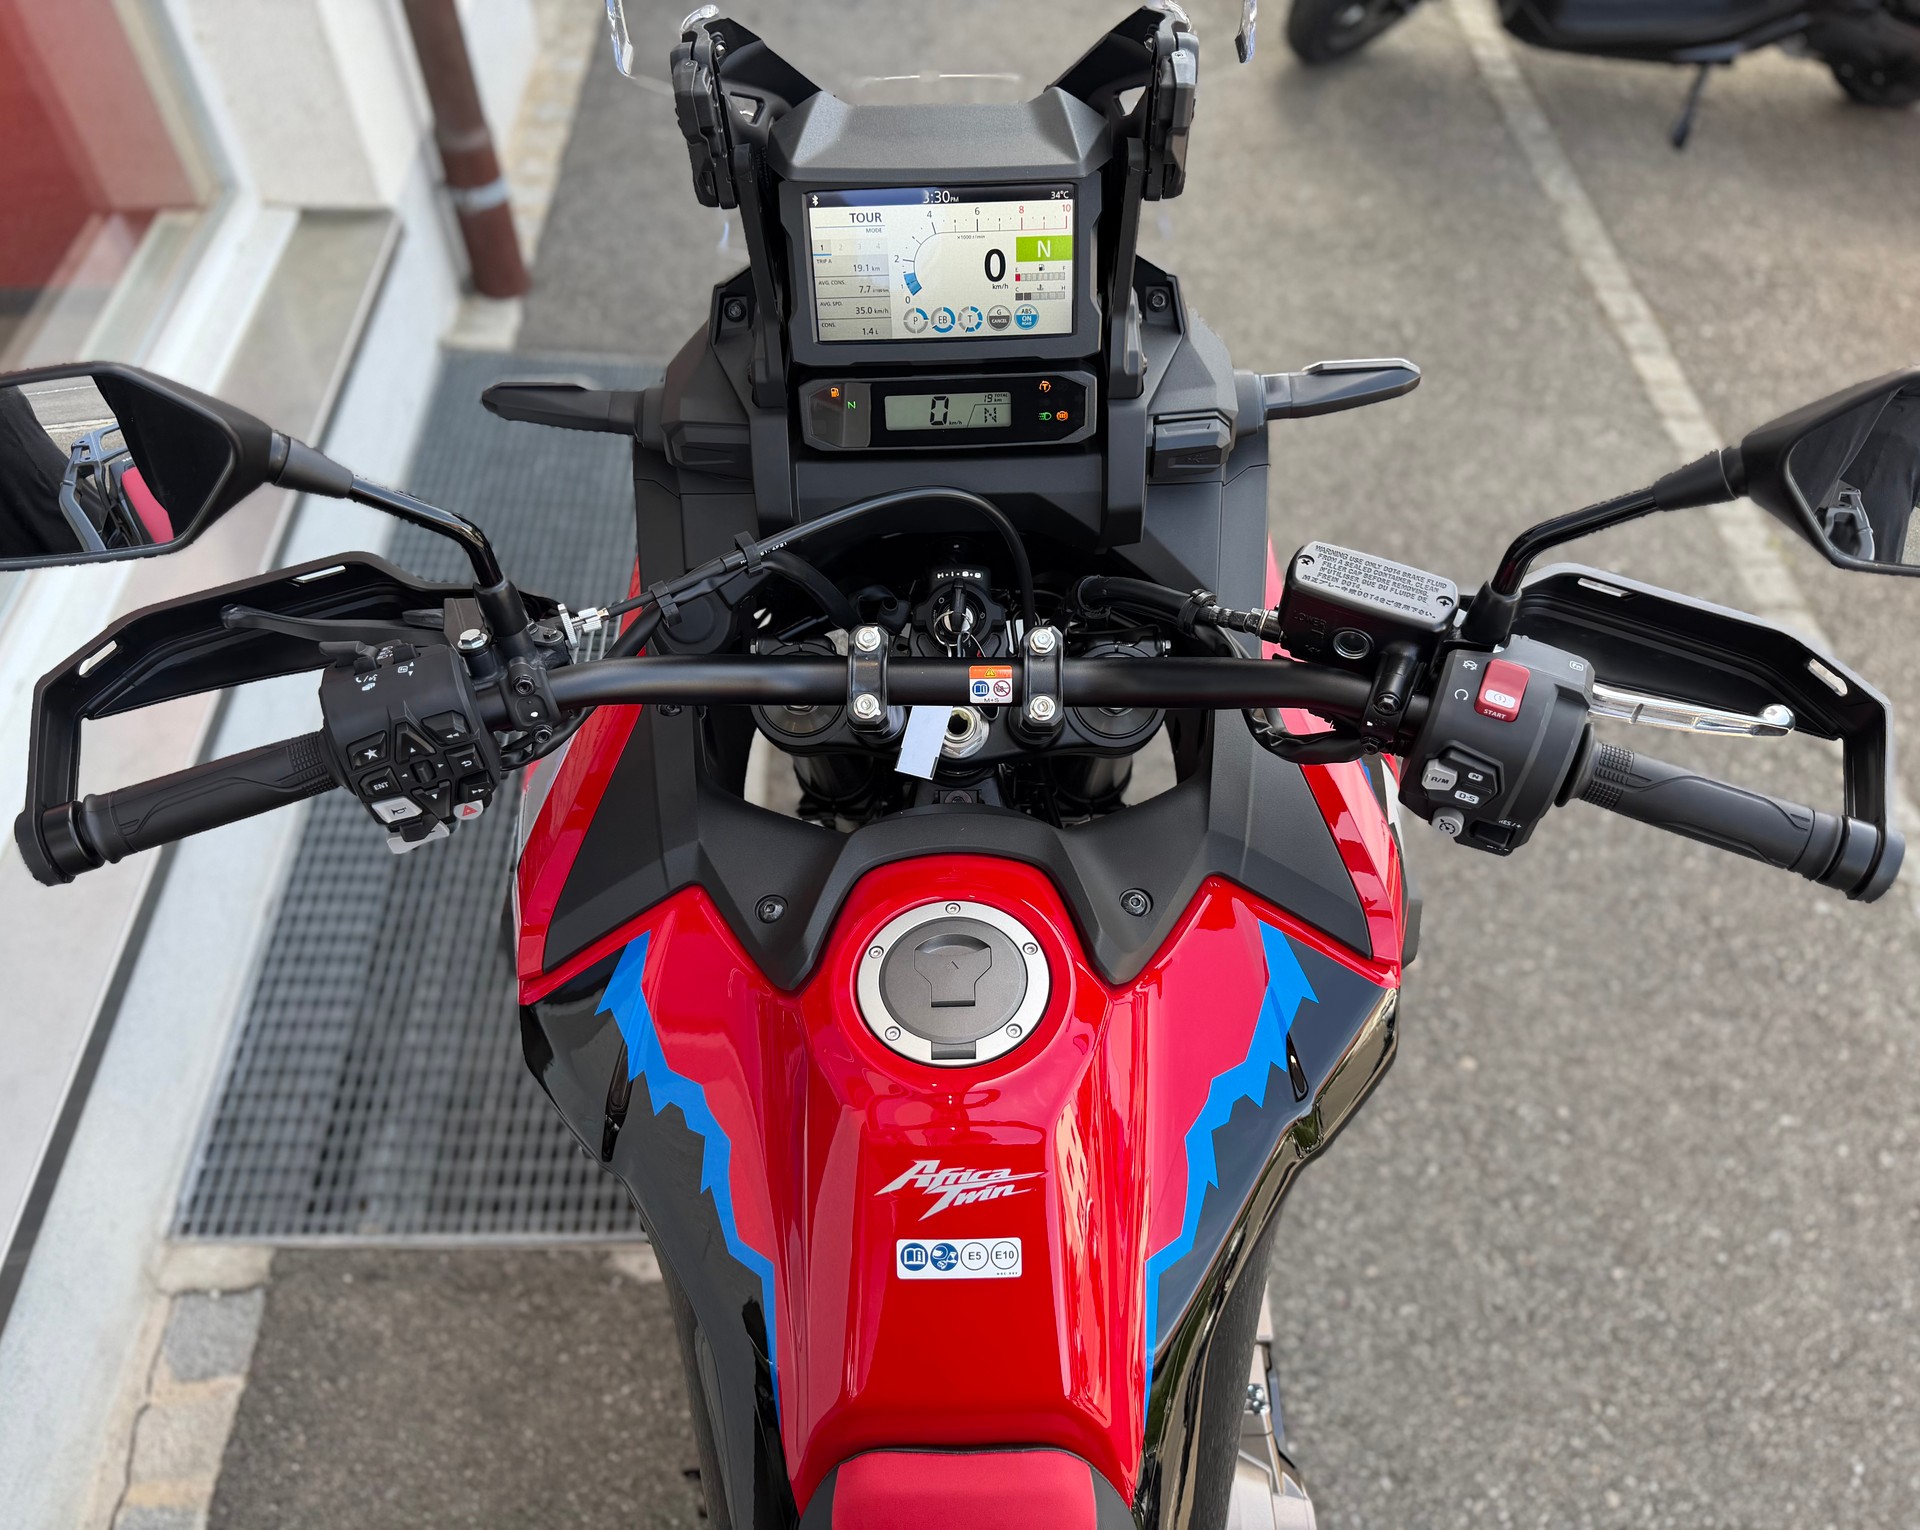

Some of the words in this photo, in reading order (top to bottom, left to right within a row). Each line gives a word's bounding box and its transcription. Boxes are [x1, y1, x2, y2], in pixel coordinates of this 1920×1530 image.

[923, 190, 950, 204] 3:30
[1050, 190, 1069, 200] 34°C
[974, 206, 980, 215] 6
[1018, 205, 1025, 214] 8
[1062, 203, 1072, 212] 10
[848, 212, 882, 223] TOUR
[926, 210, 932, 218] 4
[1037, 240, 1051, 258] N
[894, 254, 900, 263] 2
[853, 264, 870, 272] 19.1
[984, 248, 1006, 282] 0
[859, 285, 871, 293] 7.7
[905, 295, 911, 304] 0
[855, 306, 873, 315] 35.0
[913, 316, 919, 325] P
[938, 315, 948, 324] EB
[967, 315, 973, 323] T
[862, 327, 874, 335] 1.4
[984, 393, 993, 403] 19
[847, 401, 856, 409] N
[930, 395, 949, 426] 0
[984, 407, 997, 423] N
[1315, 544, 1349, 560] WARNING
[1349, 555, 1364, 565] USE
[1364, 560, 1383, 570] ONLY
[1383, 566, 1401, 575] DOT4
[1401, 571, 1425, 583] BRAKE
[1426, 578, 1447, 589] FLUID
[1317, 553, 1338, 563] FROM
[1344, 560, 1373, 574] SEALED
[1373, 569, 1414, 587] CONTAINER.
[1415, 581, 1440, 593] CLEAN
[1317, 572, 1339, 583] FREIN
[1321, 560, 1347, 573] FILLER
[1348, 568, 1362, 577] CAP
[1362, 572, 1391, 586] BEFORE
[1391, 581, 1429, 597] REMOVING.
[1361, 578, 1377, 588] QUE
[1378, 583, 1389, 591] DU
[1389, 587, 1416, 600] FLUIDE
[1417, 595, 1428, 604] DE
[1293, 609, 1327, 629] LOWER
[1483, 708, 1506, 719] START
[1430, 776, 1450, 785] A/M
[373, 781, 388, 791] ENT
[874, 1159, 1045, 1196] Africa
[918, 1183, 1032, 1222] Twin
[968, 1251, 982, 1261] E5
[995, 1250, 1015, 1260] E10
